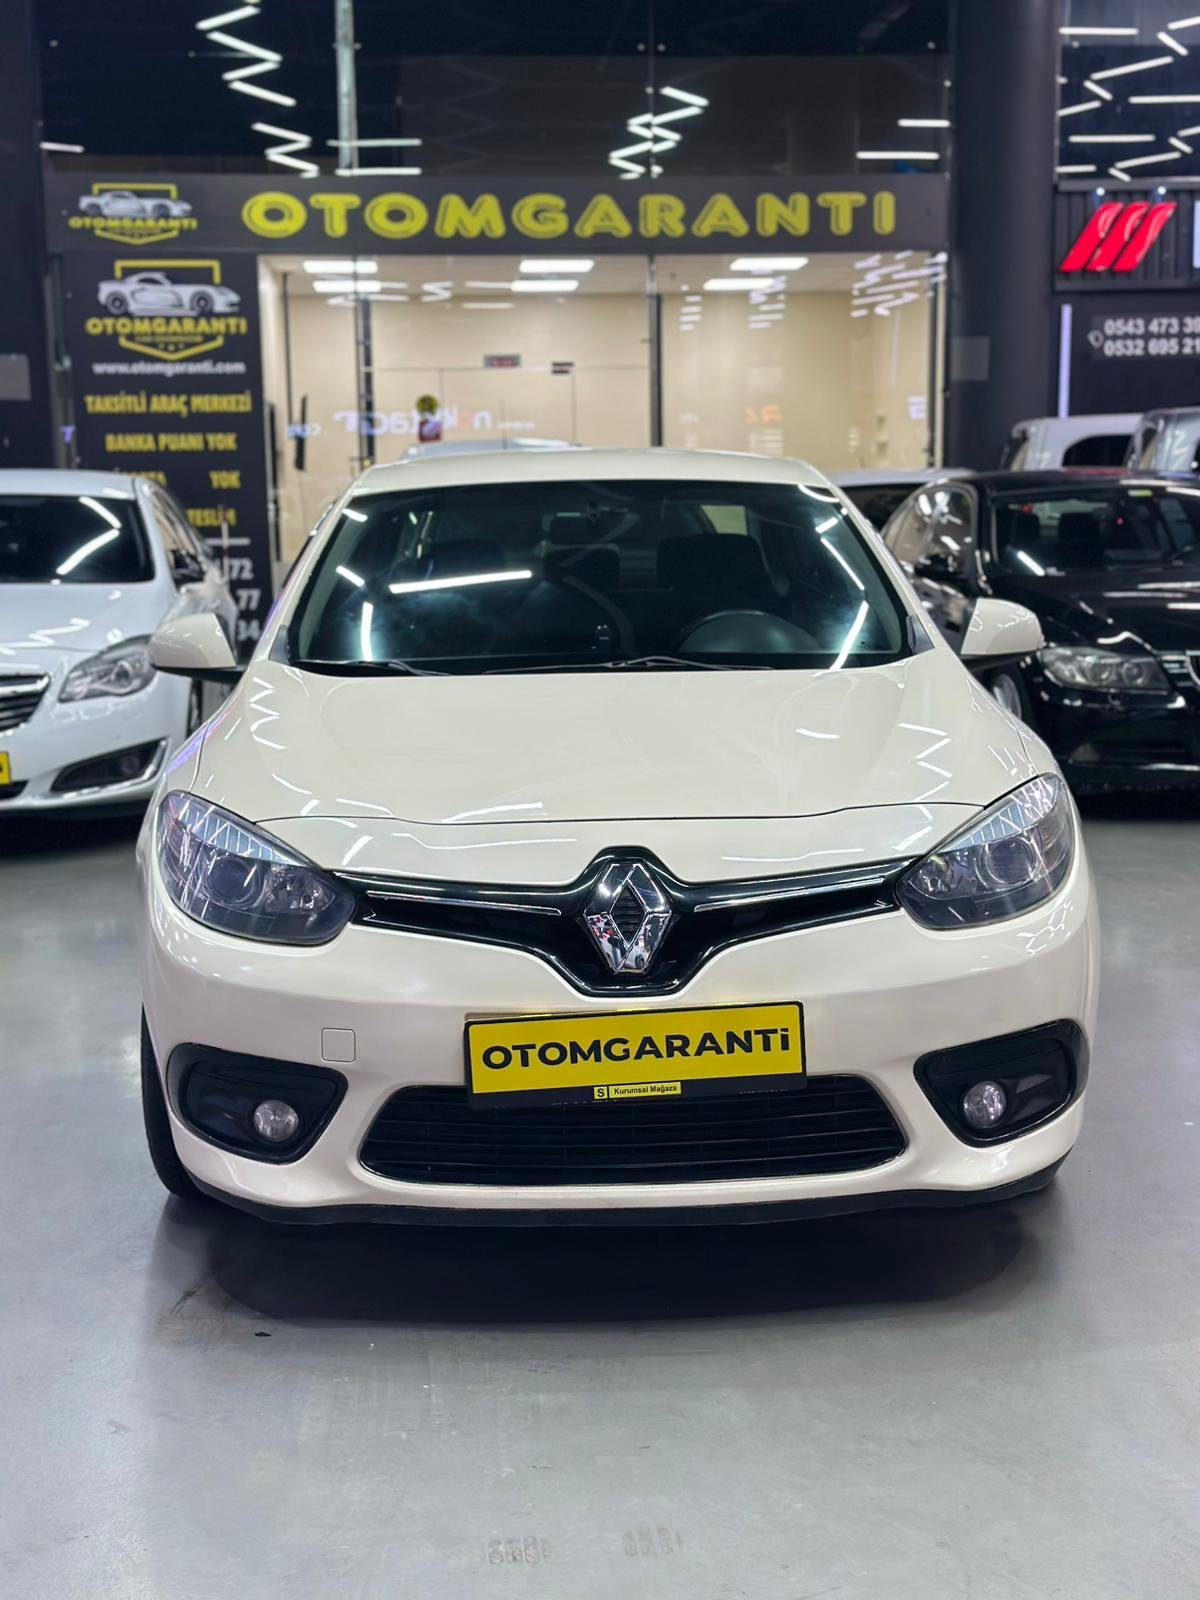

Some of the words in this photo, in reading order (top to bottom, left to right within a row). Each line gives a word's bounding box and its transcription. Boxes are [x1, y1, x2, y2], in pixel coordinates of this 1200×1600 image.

[68, 216, 197, 230] OTOMGARANTI
[241, 191, 897, 239] OTOMGARANTI
[85, 317, 247, 335] OTOMGARANTI
[1103, 318, 1145, 336] 0543
[1148, 316, 1179, 335] 473
[1103, 339, 1145, 357] 0532
[92, 360, 246, 377] www.otomgaranti.com
[150, 395, 188, 417] ARAÇ
[191, 390, 252, 412] MERKEZİ
[105, 433, 155, 452] BANKA
[158, 433, 204, 452] PUANI
[206, 433, 237, 450] YOK
[209, 471, 241, 489] YOK
[614, 1086, 649, 1095] Kurumsal
[651, 1083, 677, 1093] Mağaza
